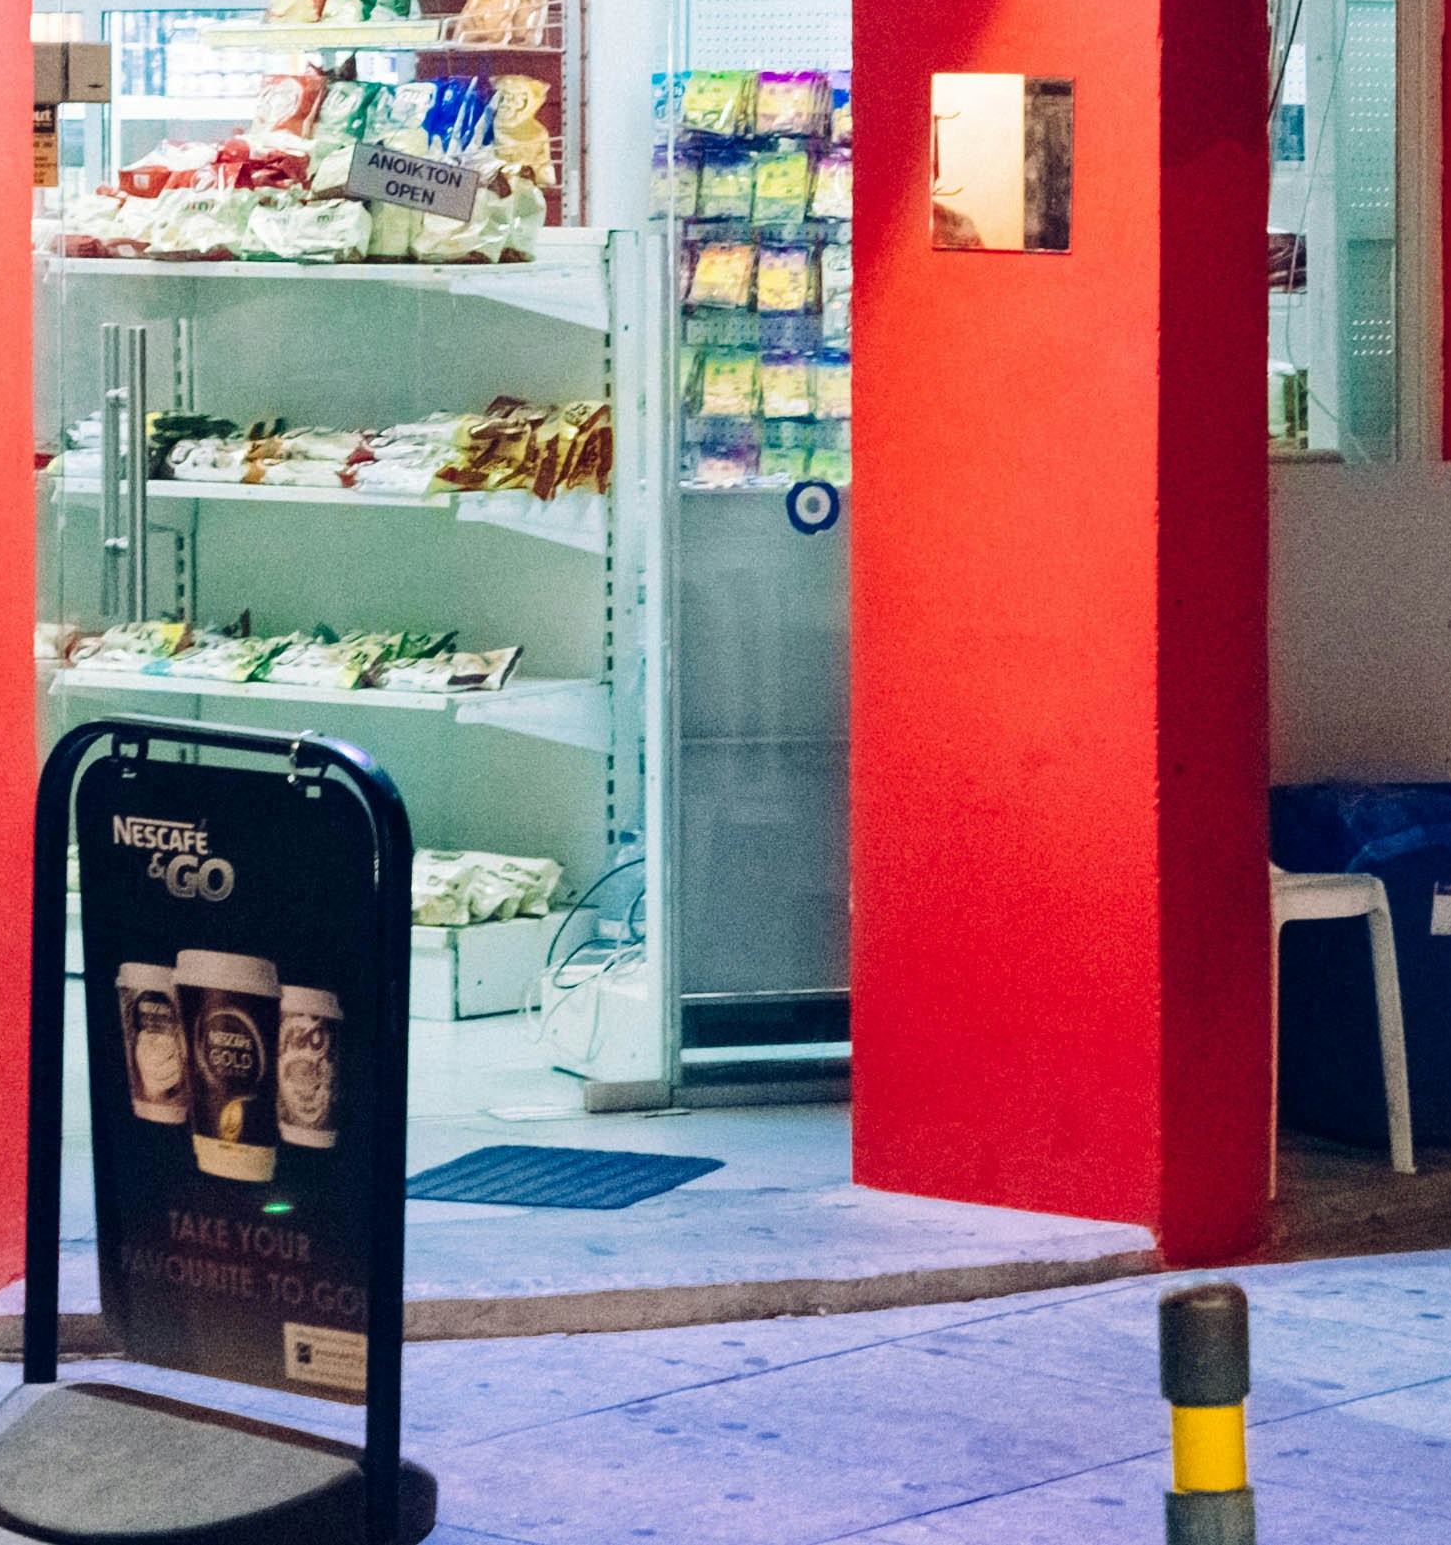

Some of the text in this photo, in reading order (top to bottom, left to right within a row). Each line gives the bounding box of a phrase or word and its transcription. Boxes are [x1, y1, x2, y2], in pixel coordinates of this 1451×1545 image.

[385, 179, 436, 206] OPEN
[169, 1208, 312, 1263] TAKE YOUR
[121, 1243, 253, 1298] FAVOURITE
[267, 1272, 305, 1305] TO
